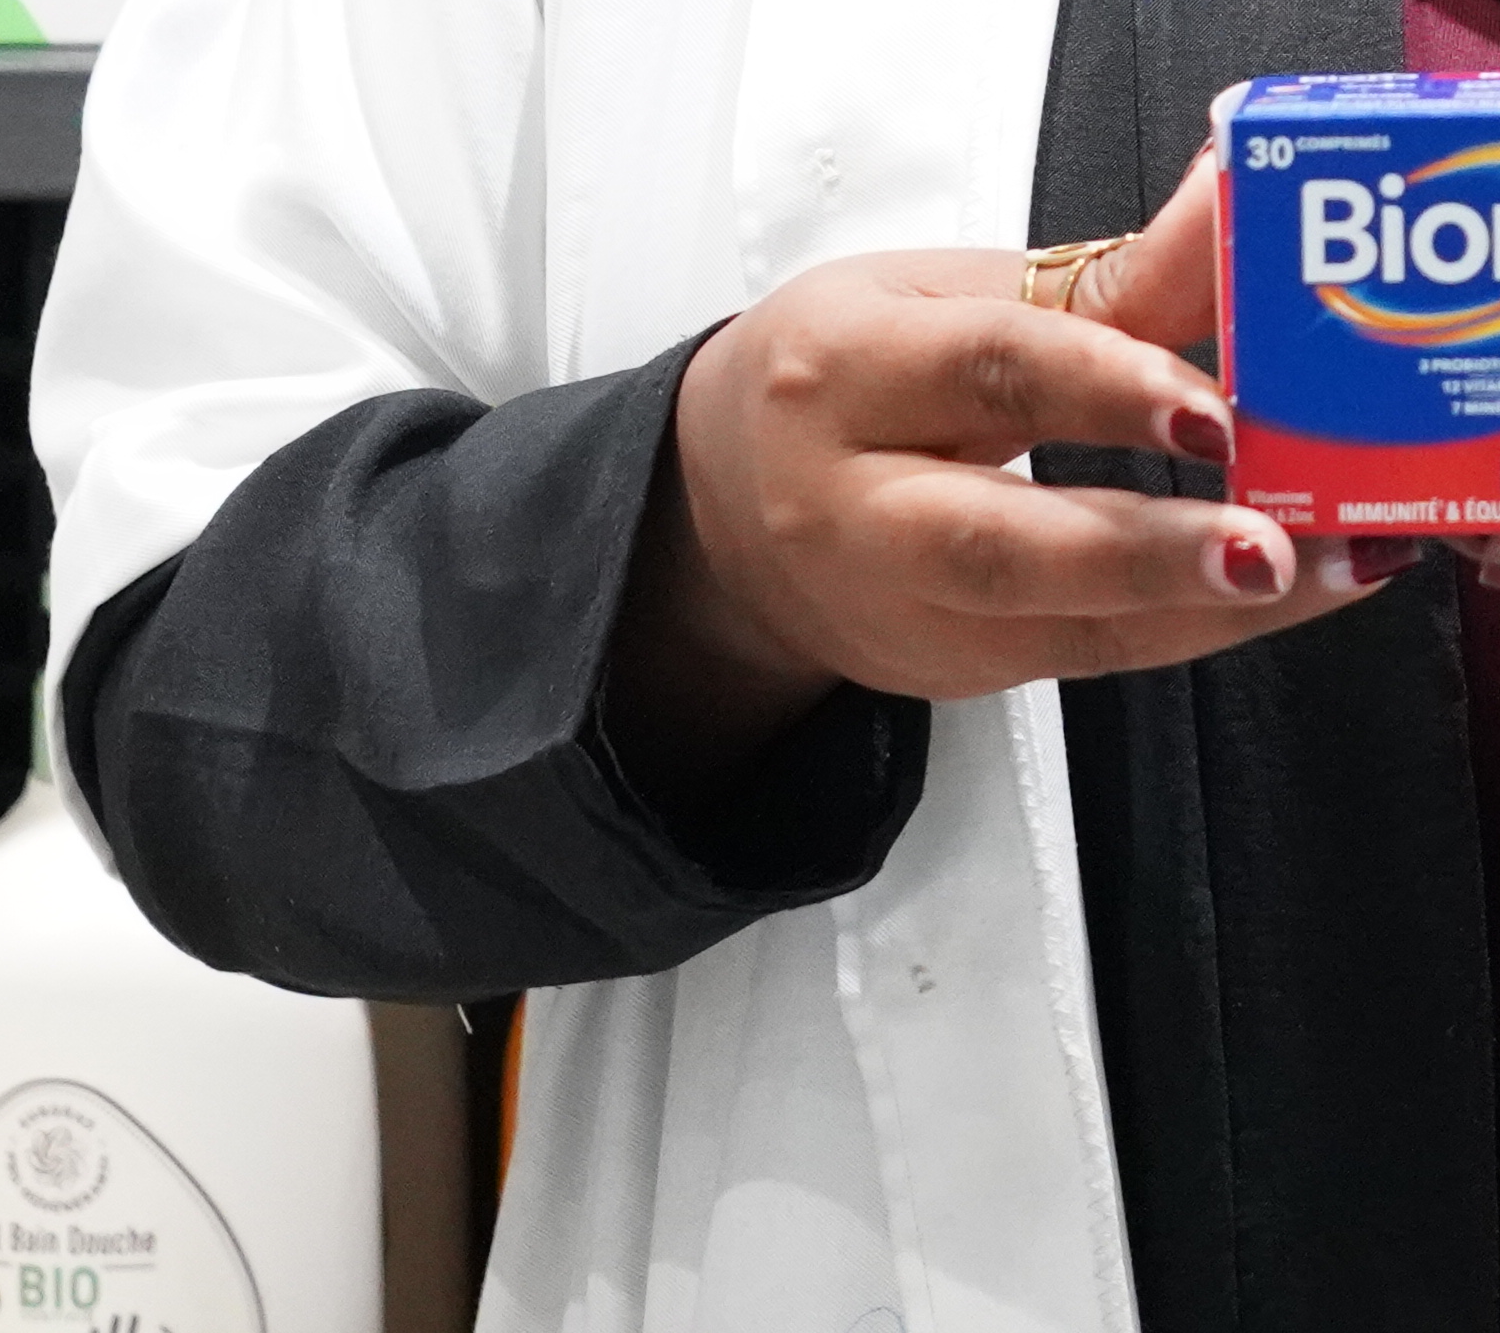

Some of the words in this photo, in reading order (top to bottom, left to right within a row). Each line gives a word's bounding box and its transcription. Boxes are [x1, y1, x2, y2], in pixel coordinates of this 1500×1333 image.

[1246, 135, 1294, 171] 30
[1247, 489, 1313, 506] Vitamines
[1445, 501, 1460, 523] &
[68, 1221, 158, 1255] Douche
[18, 1265, 101, 1310] BIO
